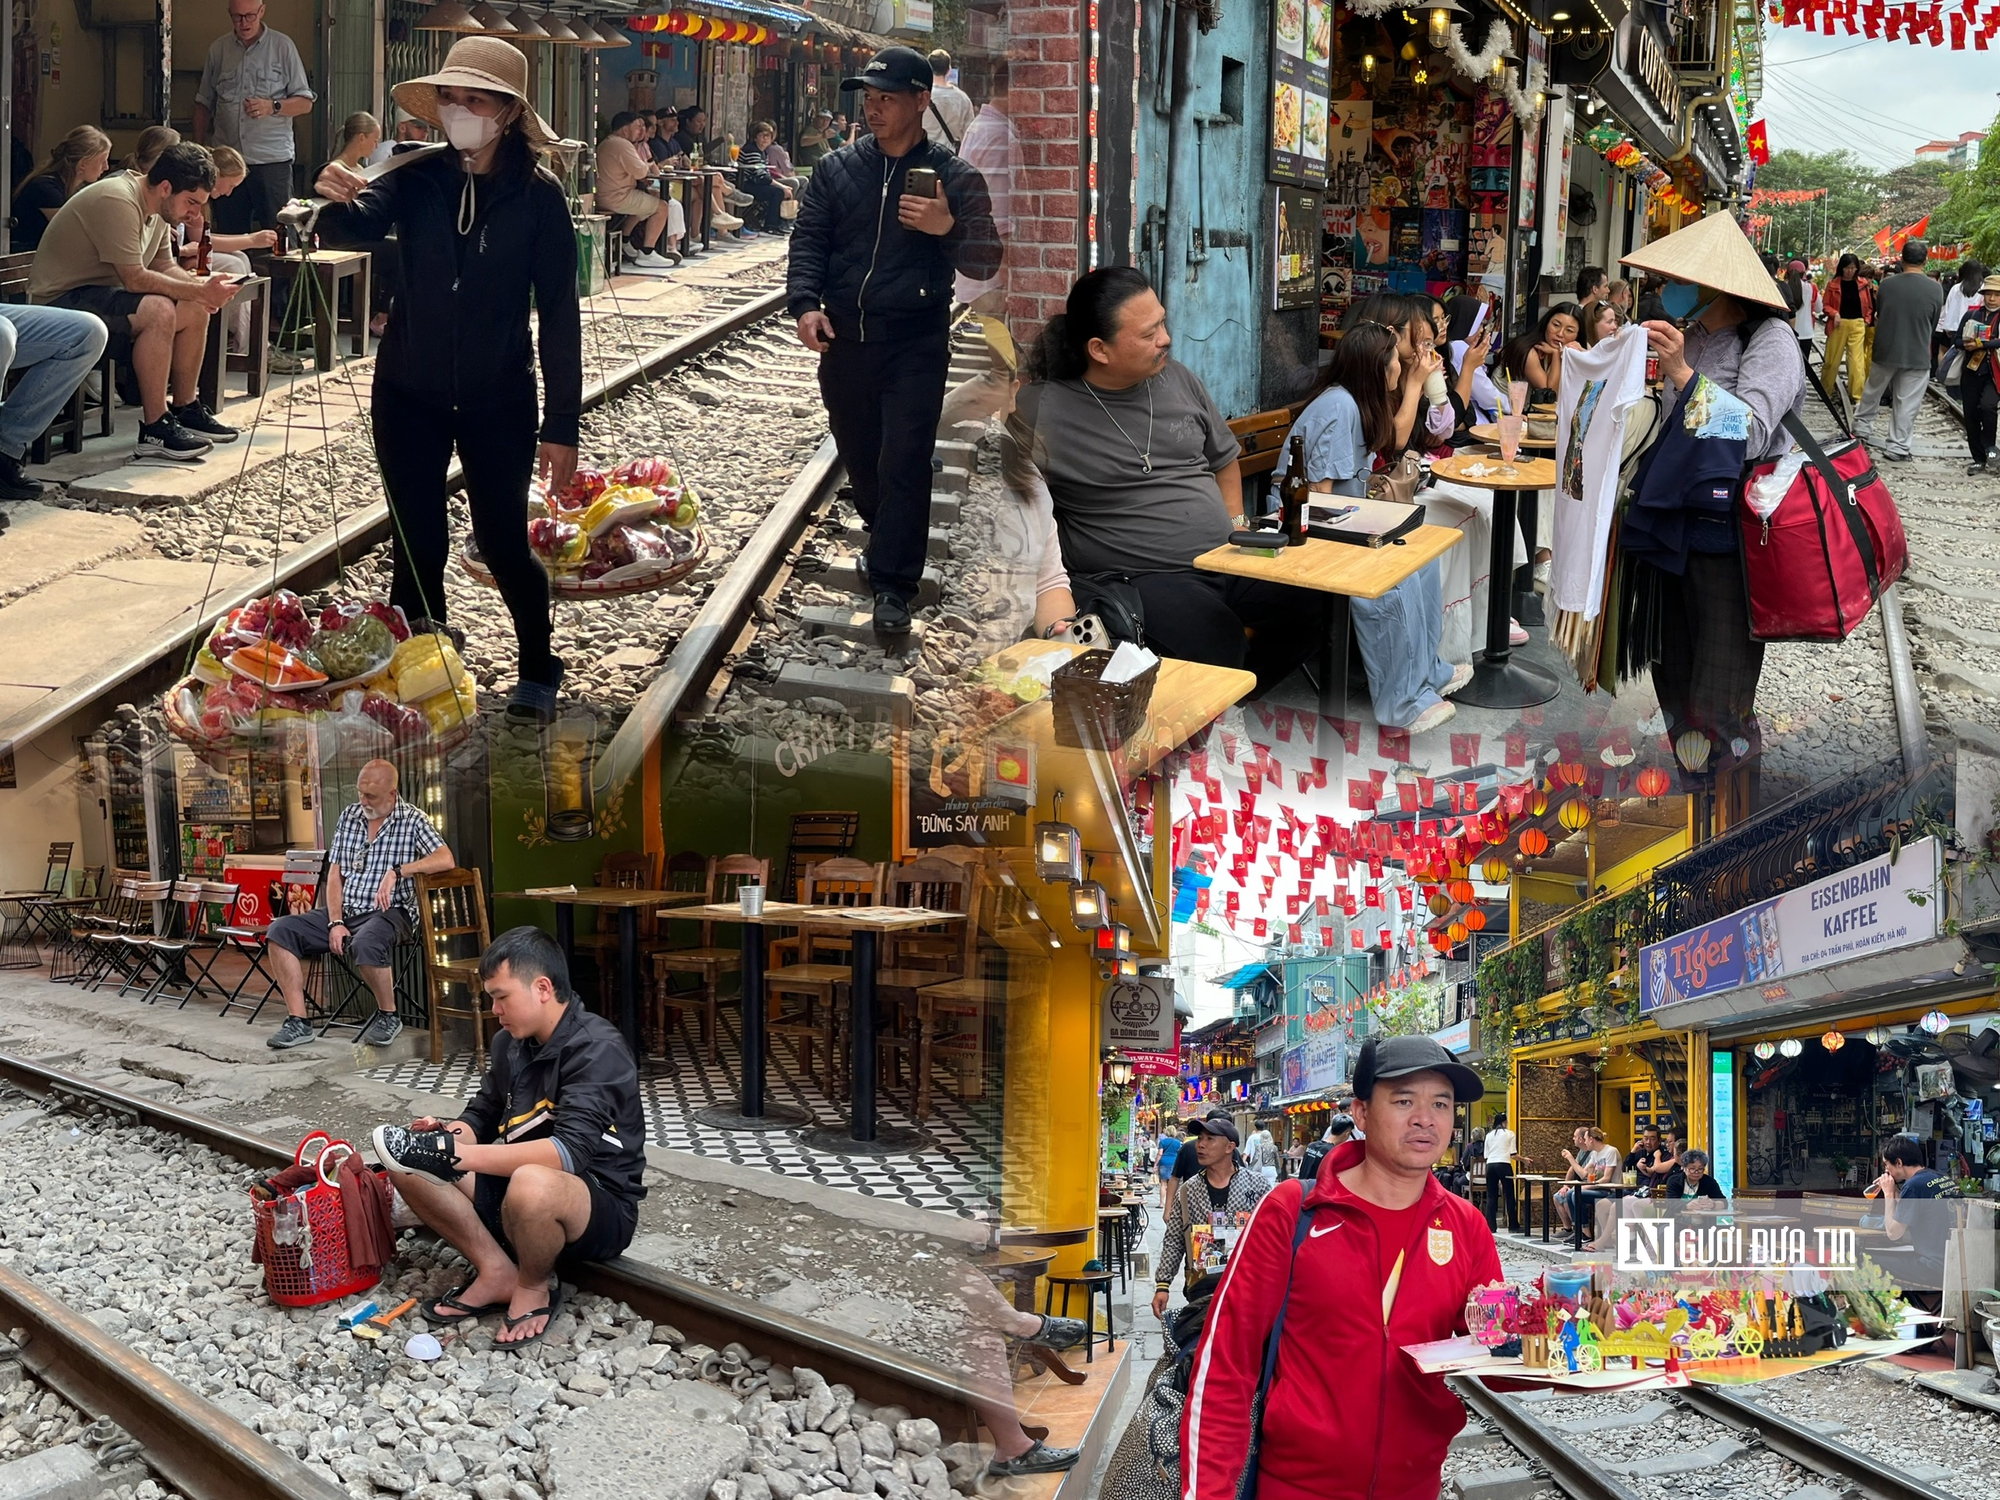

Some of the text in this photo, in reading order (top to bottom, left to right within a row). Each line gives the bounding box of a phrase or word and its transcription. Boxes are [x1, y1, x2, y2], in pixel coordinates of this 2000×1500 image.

[1639, 25, 1673, 115] COFFEE
[1721, 423, 1741, 434] TRAIN
[955, 814, 979, 832] SAY
[1824, 902, 1877, 938] KAFFEE
[1670, 929, 1734, 989] Tiger
[1110, 1028, 1160, 1038] GA ĐÔNG DƯƠNG
